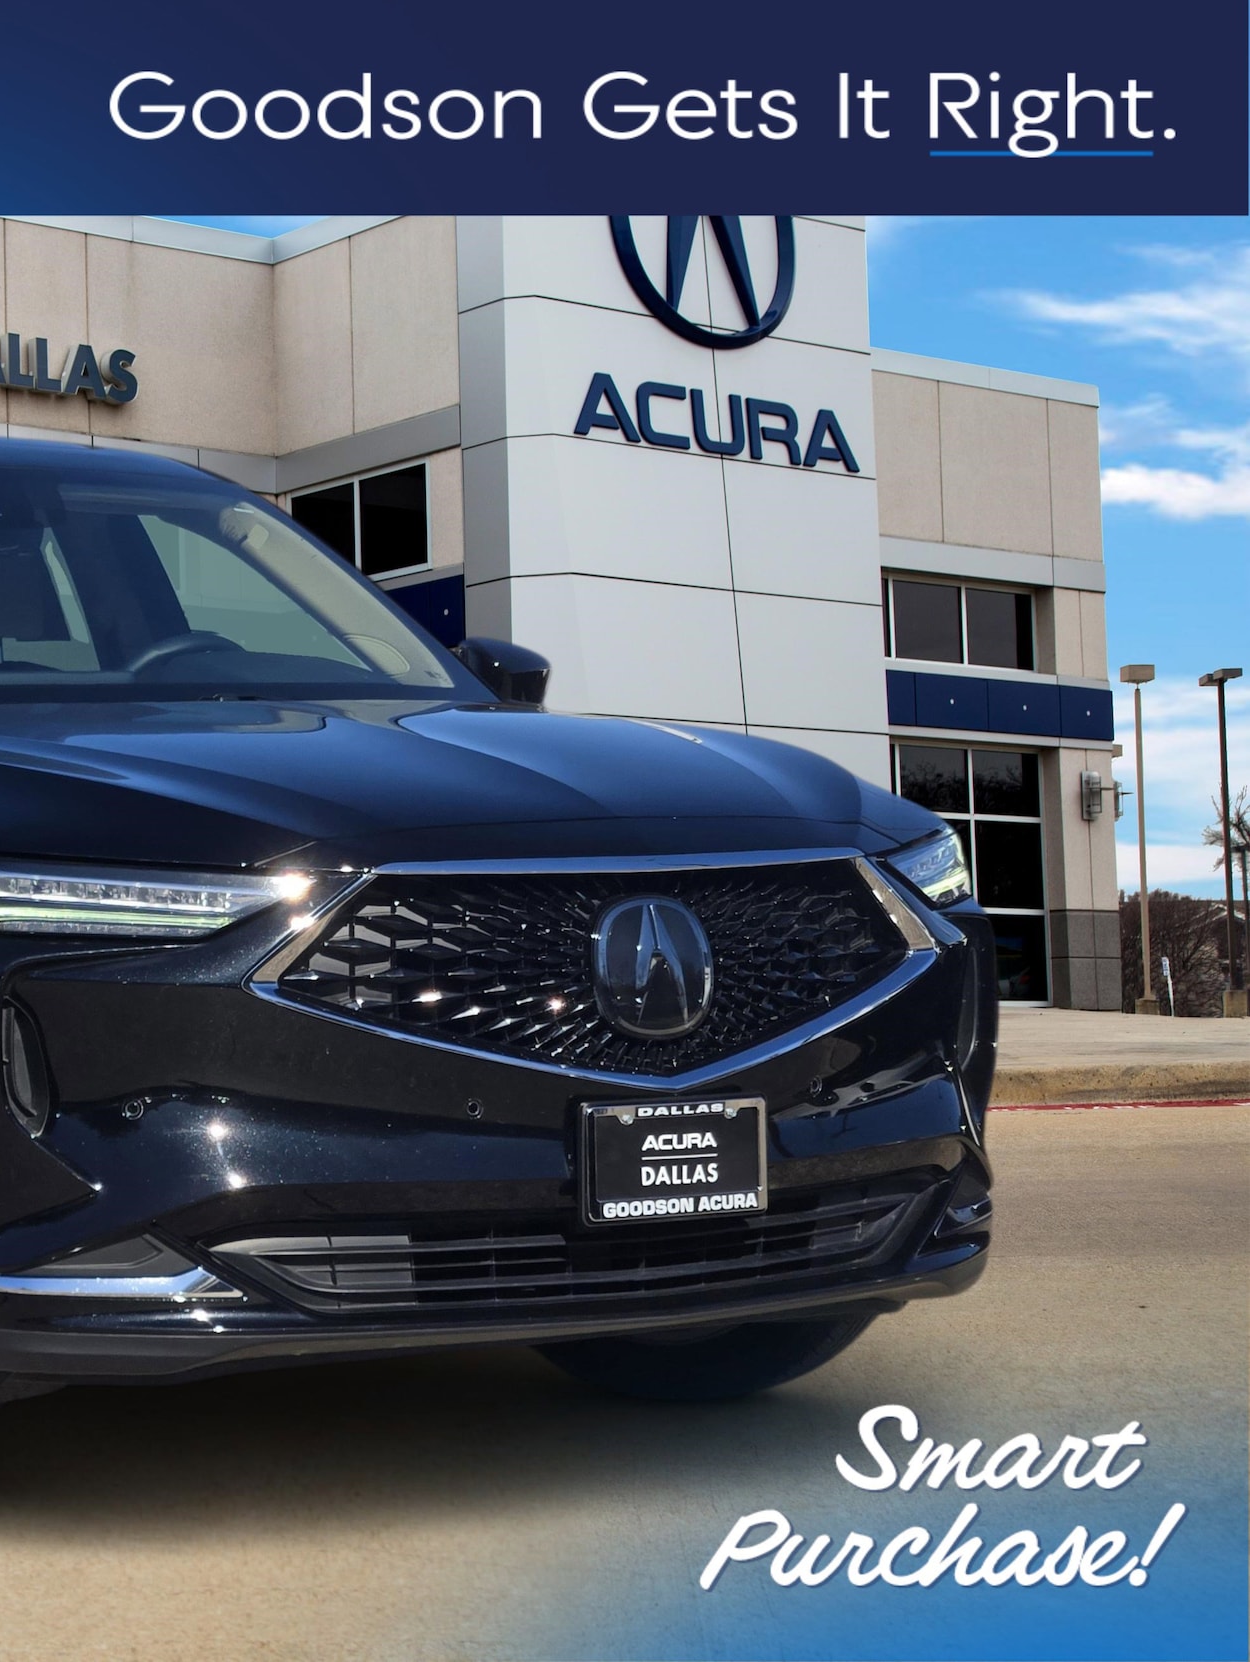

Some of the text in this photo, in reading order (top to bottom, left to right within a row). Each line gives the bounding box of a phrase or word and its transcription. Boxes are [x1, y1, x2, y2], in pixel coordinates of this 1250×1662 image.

[574, 372, 860, 473] ACURA
[637, 1103, 725, 1117] DALLAS
[641, 1131, 718, 1151] ACURA
[641, 1162, 719, 1186] DALLAS
[603, 1193, 758, 1218] GOODSON ACURA
